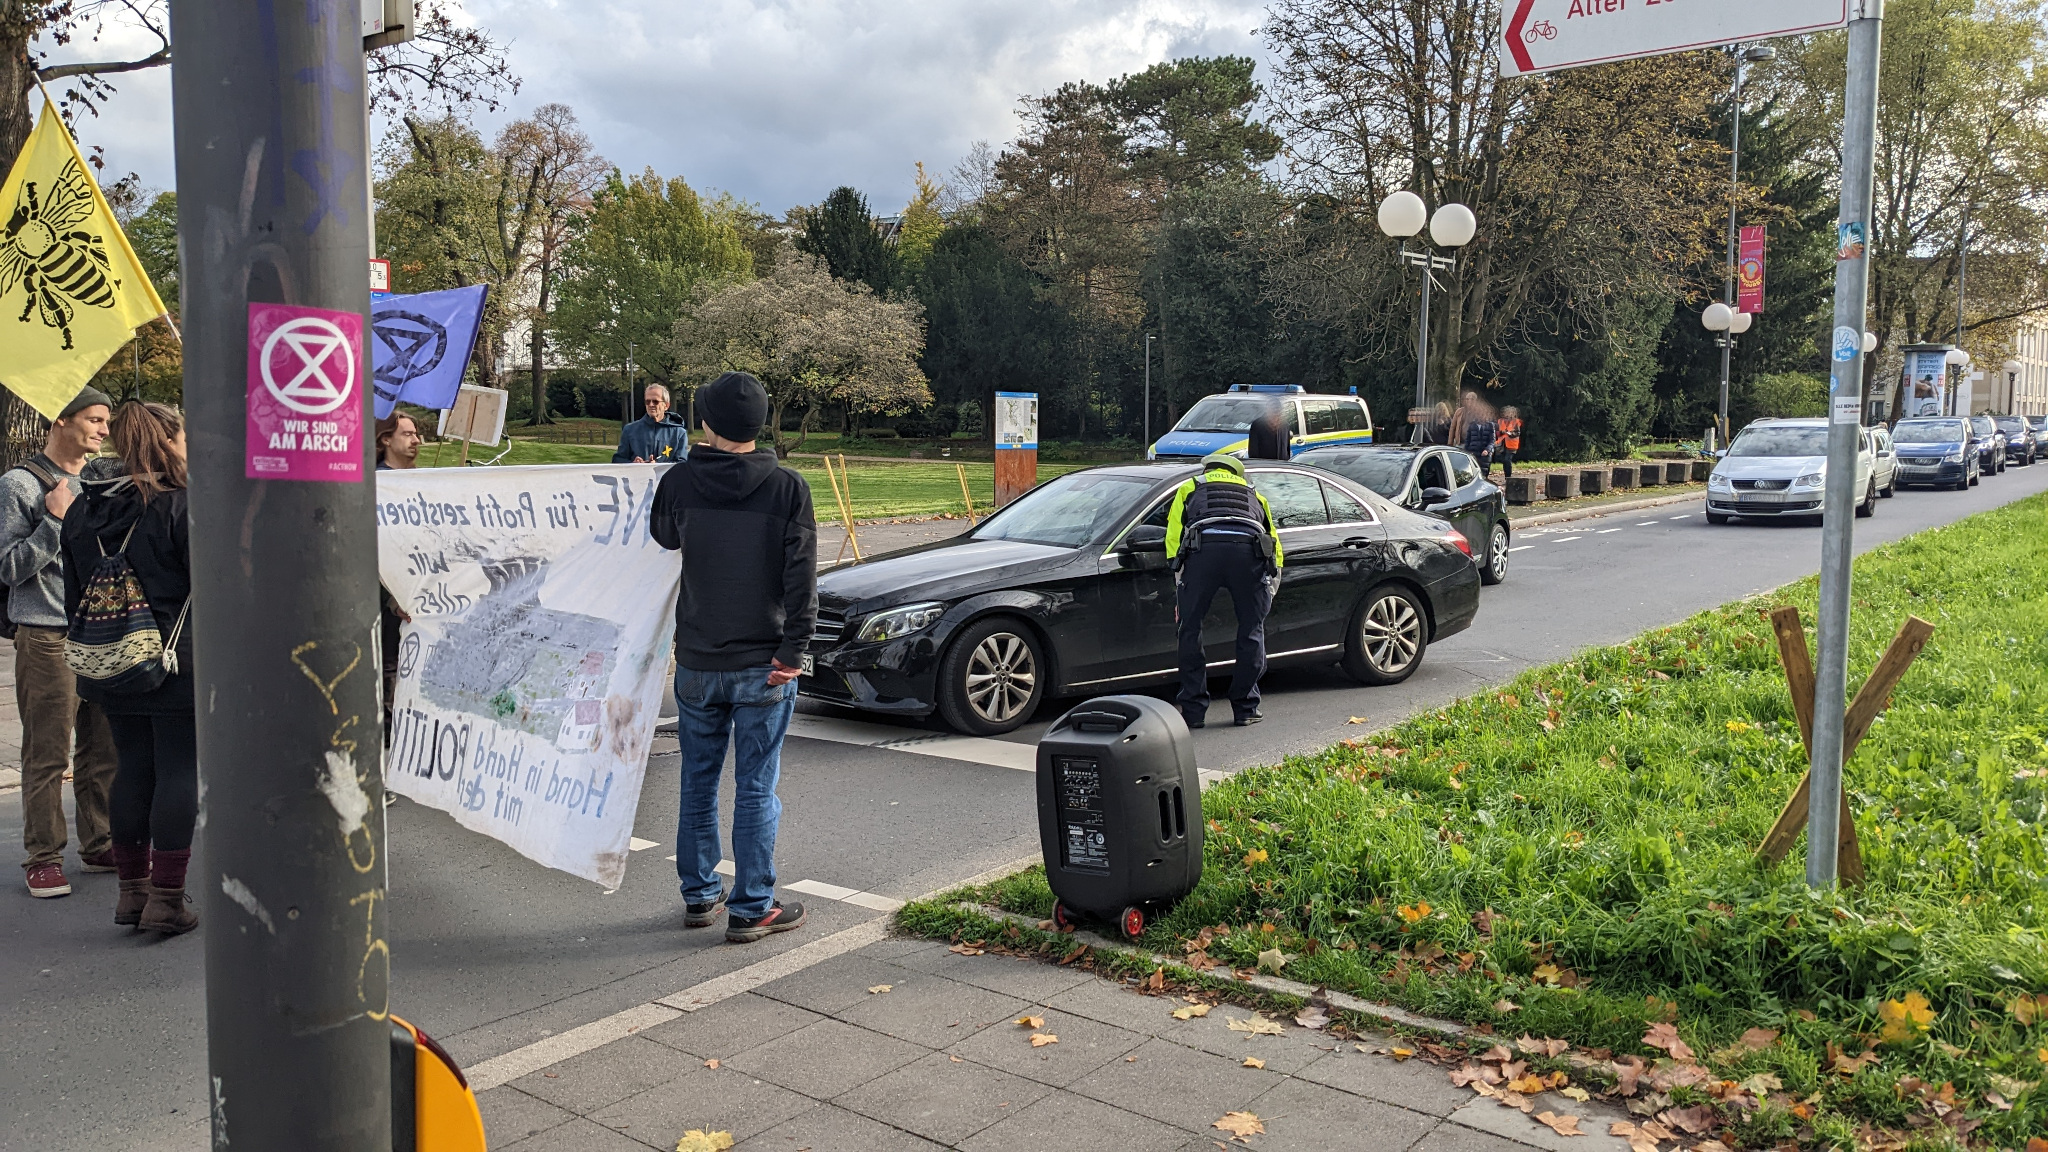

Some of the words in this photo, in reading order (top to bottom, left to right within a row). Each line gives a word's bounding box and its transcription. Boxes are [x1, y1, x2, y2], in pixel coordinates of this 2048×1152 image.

[283, 419, 308, 433] WIR
[312, 420, 338, 435] SIND
[268, 432, 297, 450] AM
[301, 434, 348, 452] ARSCH
[1169, 439, 1211, 447] POLIZEI
